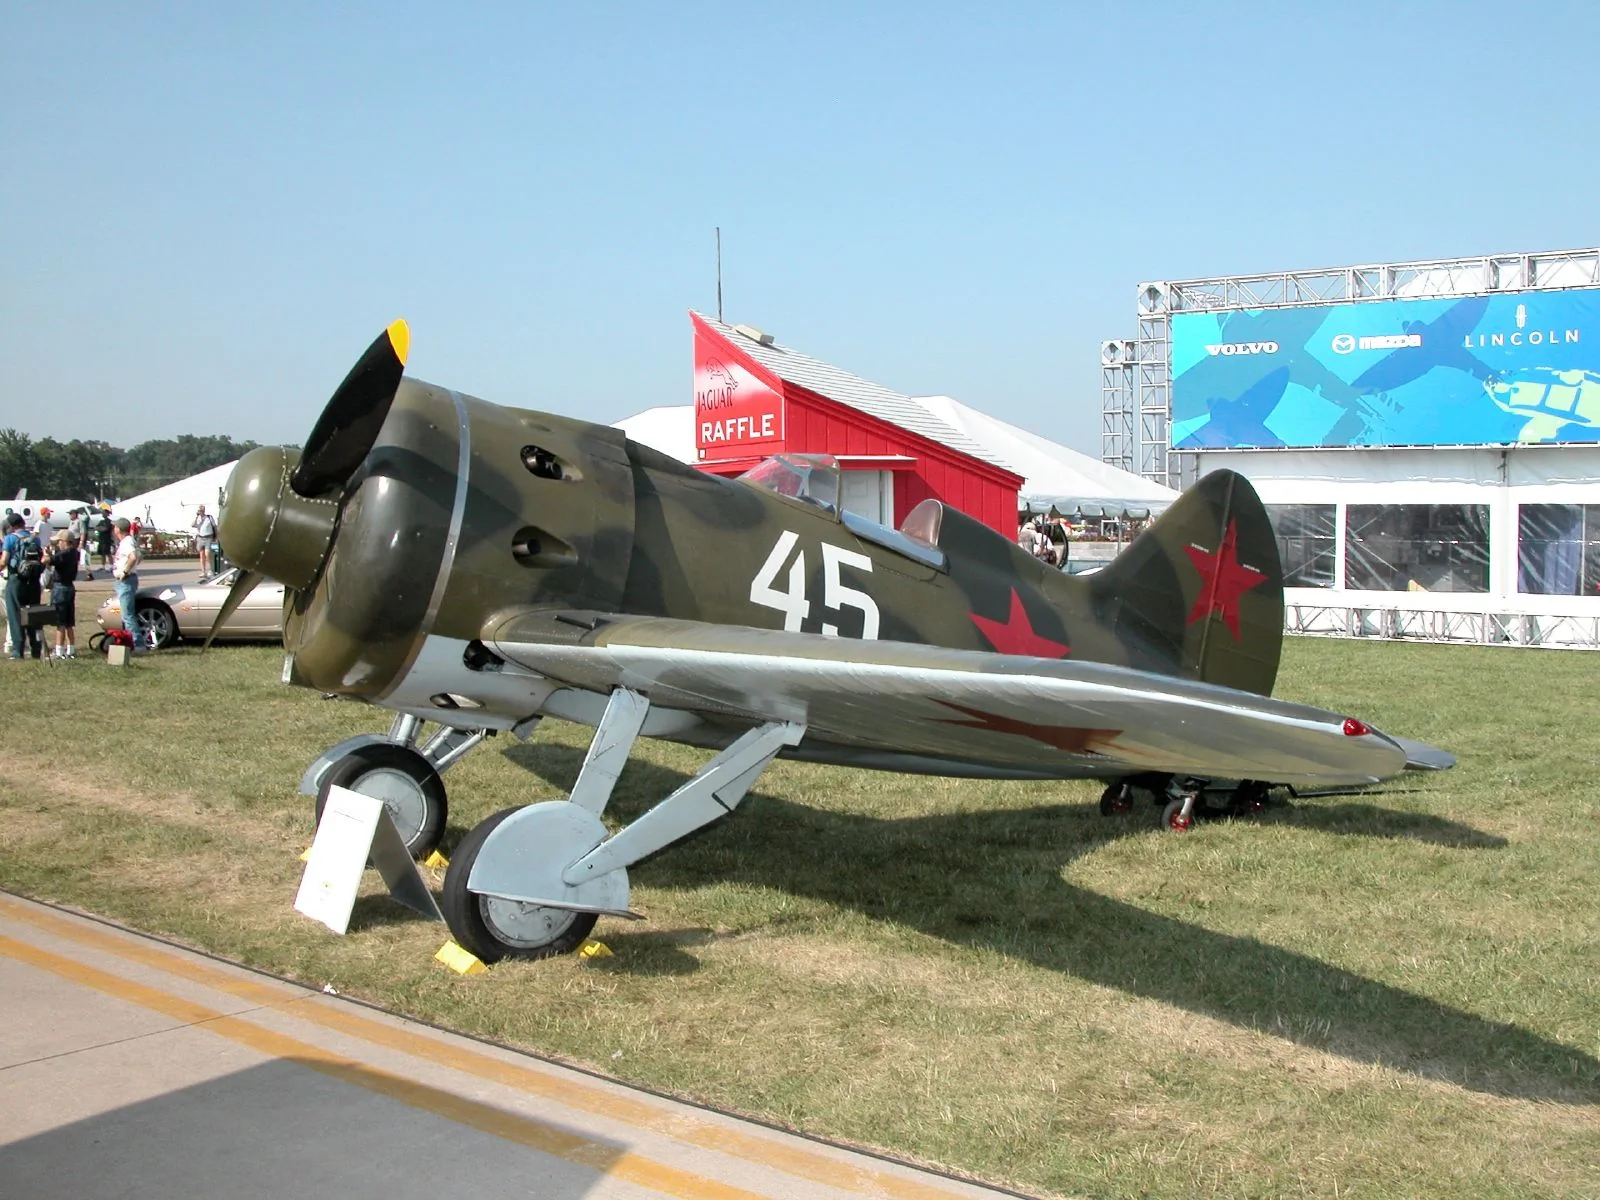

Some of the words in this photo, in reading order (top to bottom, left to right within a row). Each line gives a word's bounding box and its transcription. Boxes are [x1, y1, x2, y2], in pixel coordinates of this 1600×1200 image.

[1204, 341, 1279, 356] VOLVO
[1464, 329, 1580, 348] LINCOLN
[697, 386, 733, 417] JAGUAR
[701, 413, 775, 443] RAFFLE
[750, 529, 880, 640] 45
